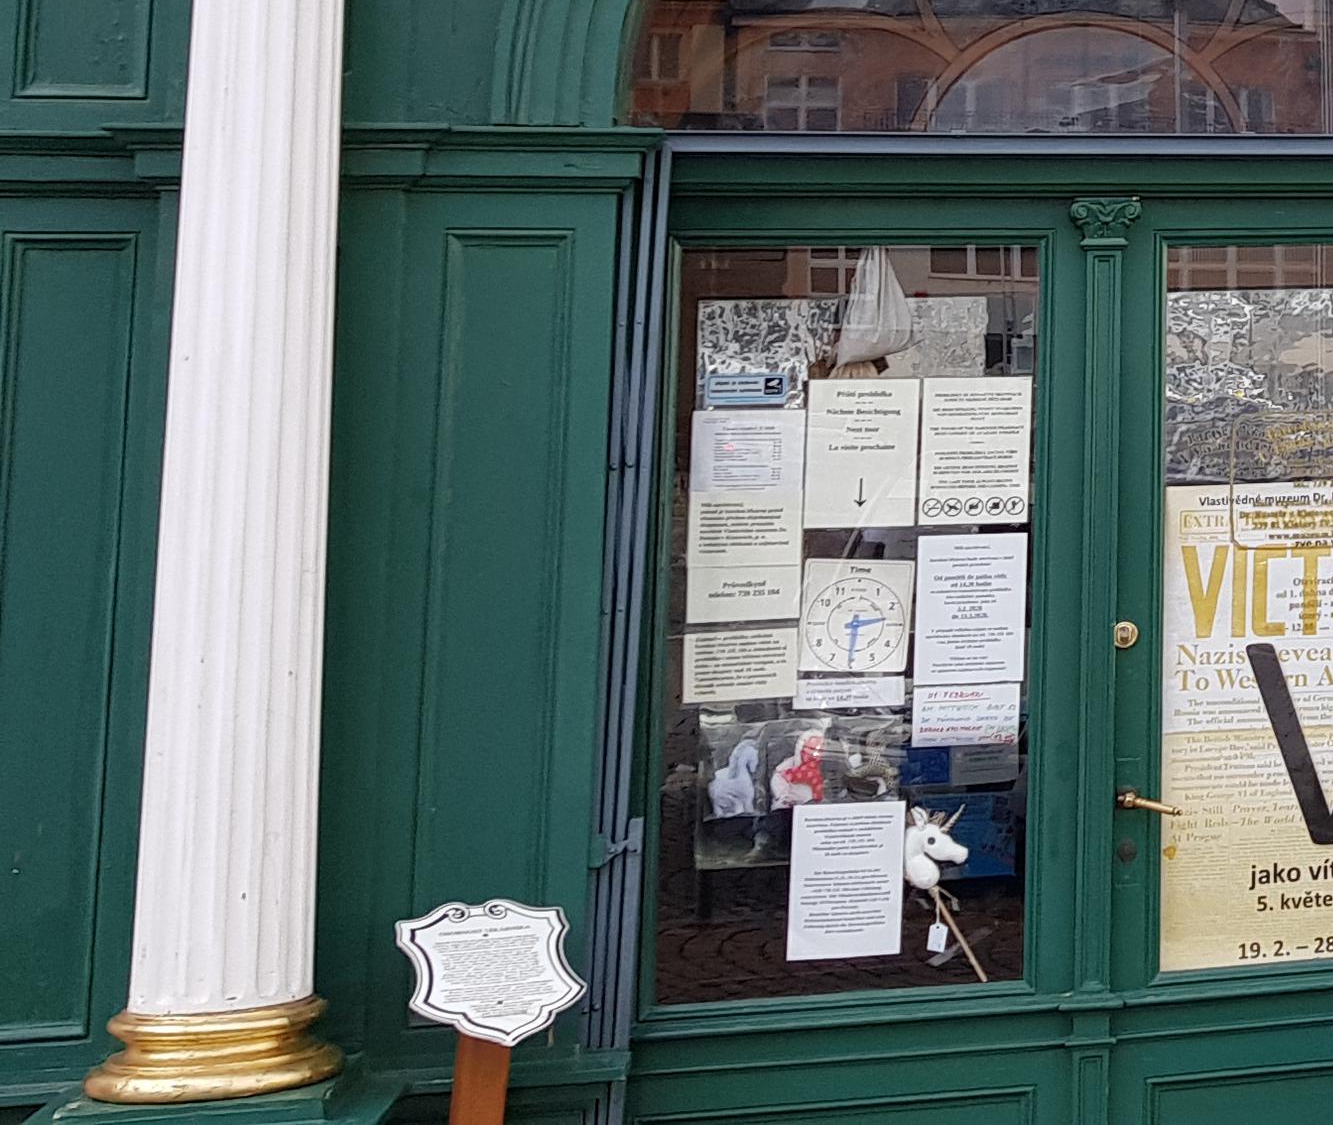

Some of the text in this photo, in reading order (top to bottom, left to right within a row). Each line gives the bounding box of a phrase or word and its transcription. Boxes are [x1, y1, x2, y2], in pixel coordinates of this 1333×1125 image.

[1265, 494, 1310, 506] muzeum
[1183, 513, 1229, 529] EXTR
[850, 566, 871, 574] Time
[835, 587, 845, 596] 11
[1175, 642, 1246, 666] Nazis
[1174, 669, 1210, 692] To
[1249, 863, 1301, 891] jako
[1256, 896, 1274, 913] 5.
[1238, 942, 1267, 960] 19.
[1273, 940, 1291, 957] 2.
